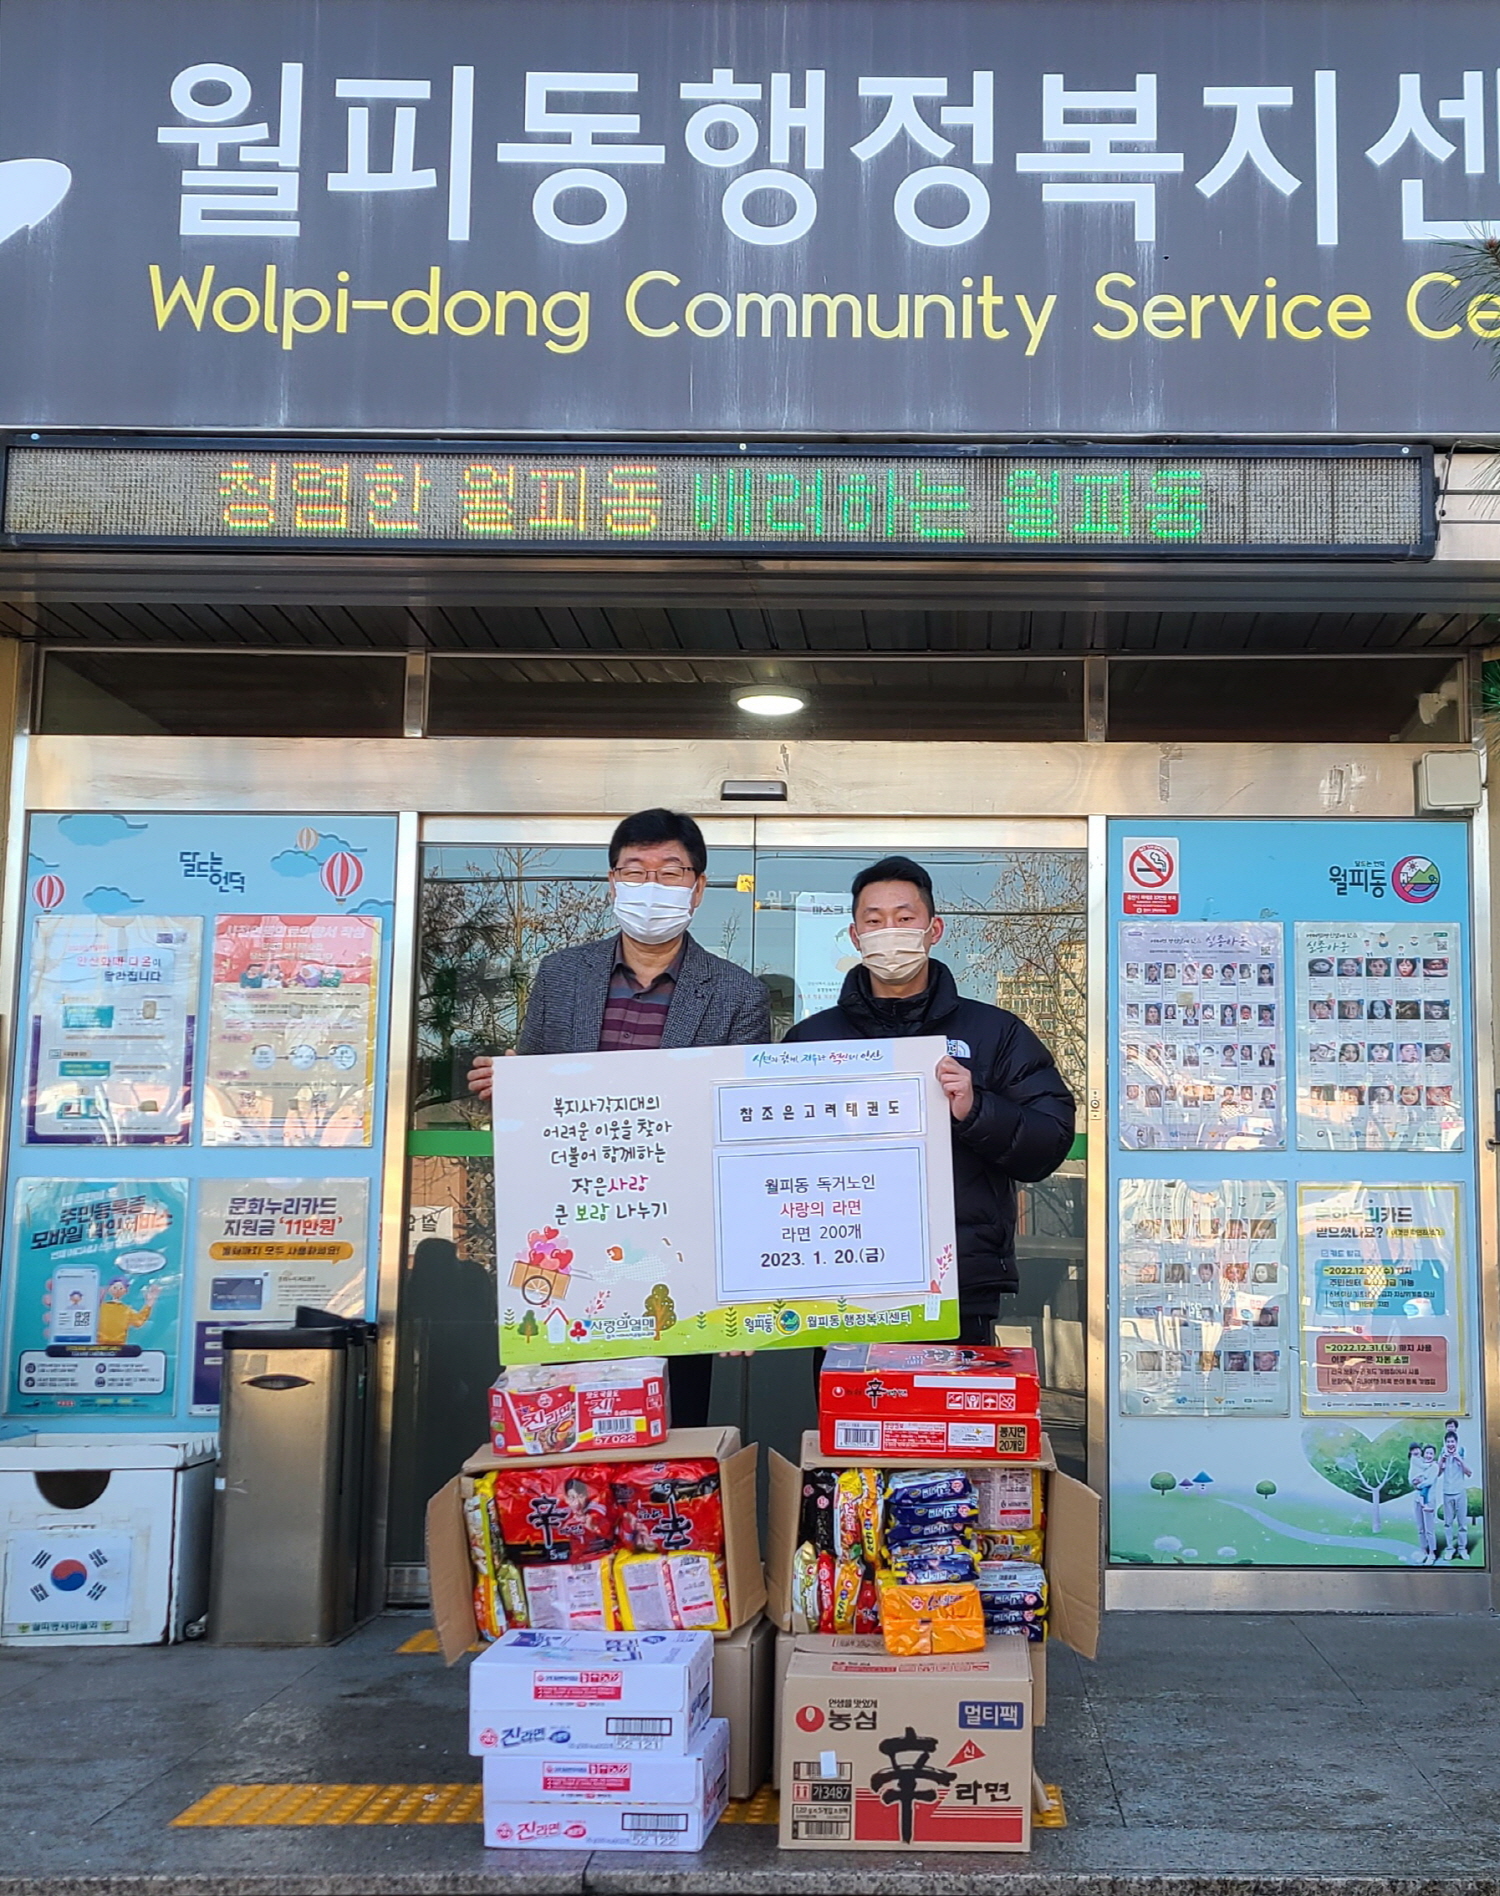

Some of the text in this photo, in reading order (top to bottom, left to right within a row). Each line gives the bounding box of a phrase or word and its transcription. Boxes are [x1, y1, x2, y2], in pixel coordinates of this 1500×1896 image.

[148, 263, 591, 354] Wolpi-dong
[625, 270, 1058, 356] Community
[1092, 272, 1372, 341] Service
[219, 460, 1208, 540] 청렴한 월피동 배려하는 월피동
[209, 872, 246, 893] 언덕
[1329, 866, 1387, 898] 월피동
[553, 1096, 660, 1118] 복지사각지대의
[543, 1118, 673, 1142] 어려운 이웃을 찾아
[551, 1142, 666, 1168] 더불어 함께하는
[764, 1173, 876, 1195] 월피동 독거노인
[228, 1197, 338, 1216] 문화누리카드
[555, 1201, 668, 1226] 큰 보람 나누기
[780, 1199, 862, 1218] 사랑의 라면
[31, 1225, 84, 1250] 모바일
[223, 1219, 276, 1236] 지원금
[782, 1223, 862, 1243] 라면 200개
[1316, 1226, 1384, 1239] 받으셨나요?
[760, 1247, 886, 1268] 2023. 1. 20.(금)
[744, 1311, 912, 1333] 월피동 월피동 행정복지센터
[864, 1377, 886, 1409] 辛
[521, 1401, 573, 1432] 진라면
[999, 1427, 1025, 1439] 봉지면
[998, 1440, 1024, 1452] 20개입
[528, 1492, 569, 1550] 辛
[828, 1709, 877, 1730] 농심
[964, 1704, 1018, 1727] 멀티팩
[501, 1727, 546, 1748] 진라면
[963, 1746, 975, 1759] 신
[812, 1785, 850, 1800] 가3487
[870, 1726, 958, 1845] 辛
[955, 1780, 1012, 1806] 라면
[517, 1821, 560, 1843] 진라면
